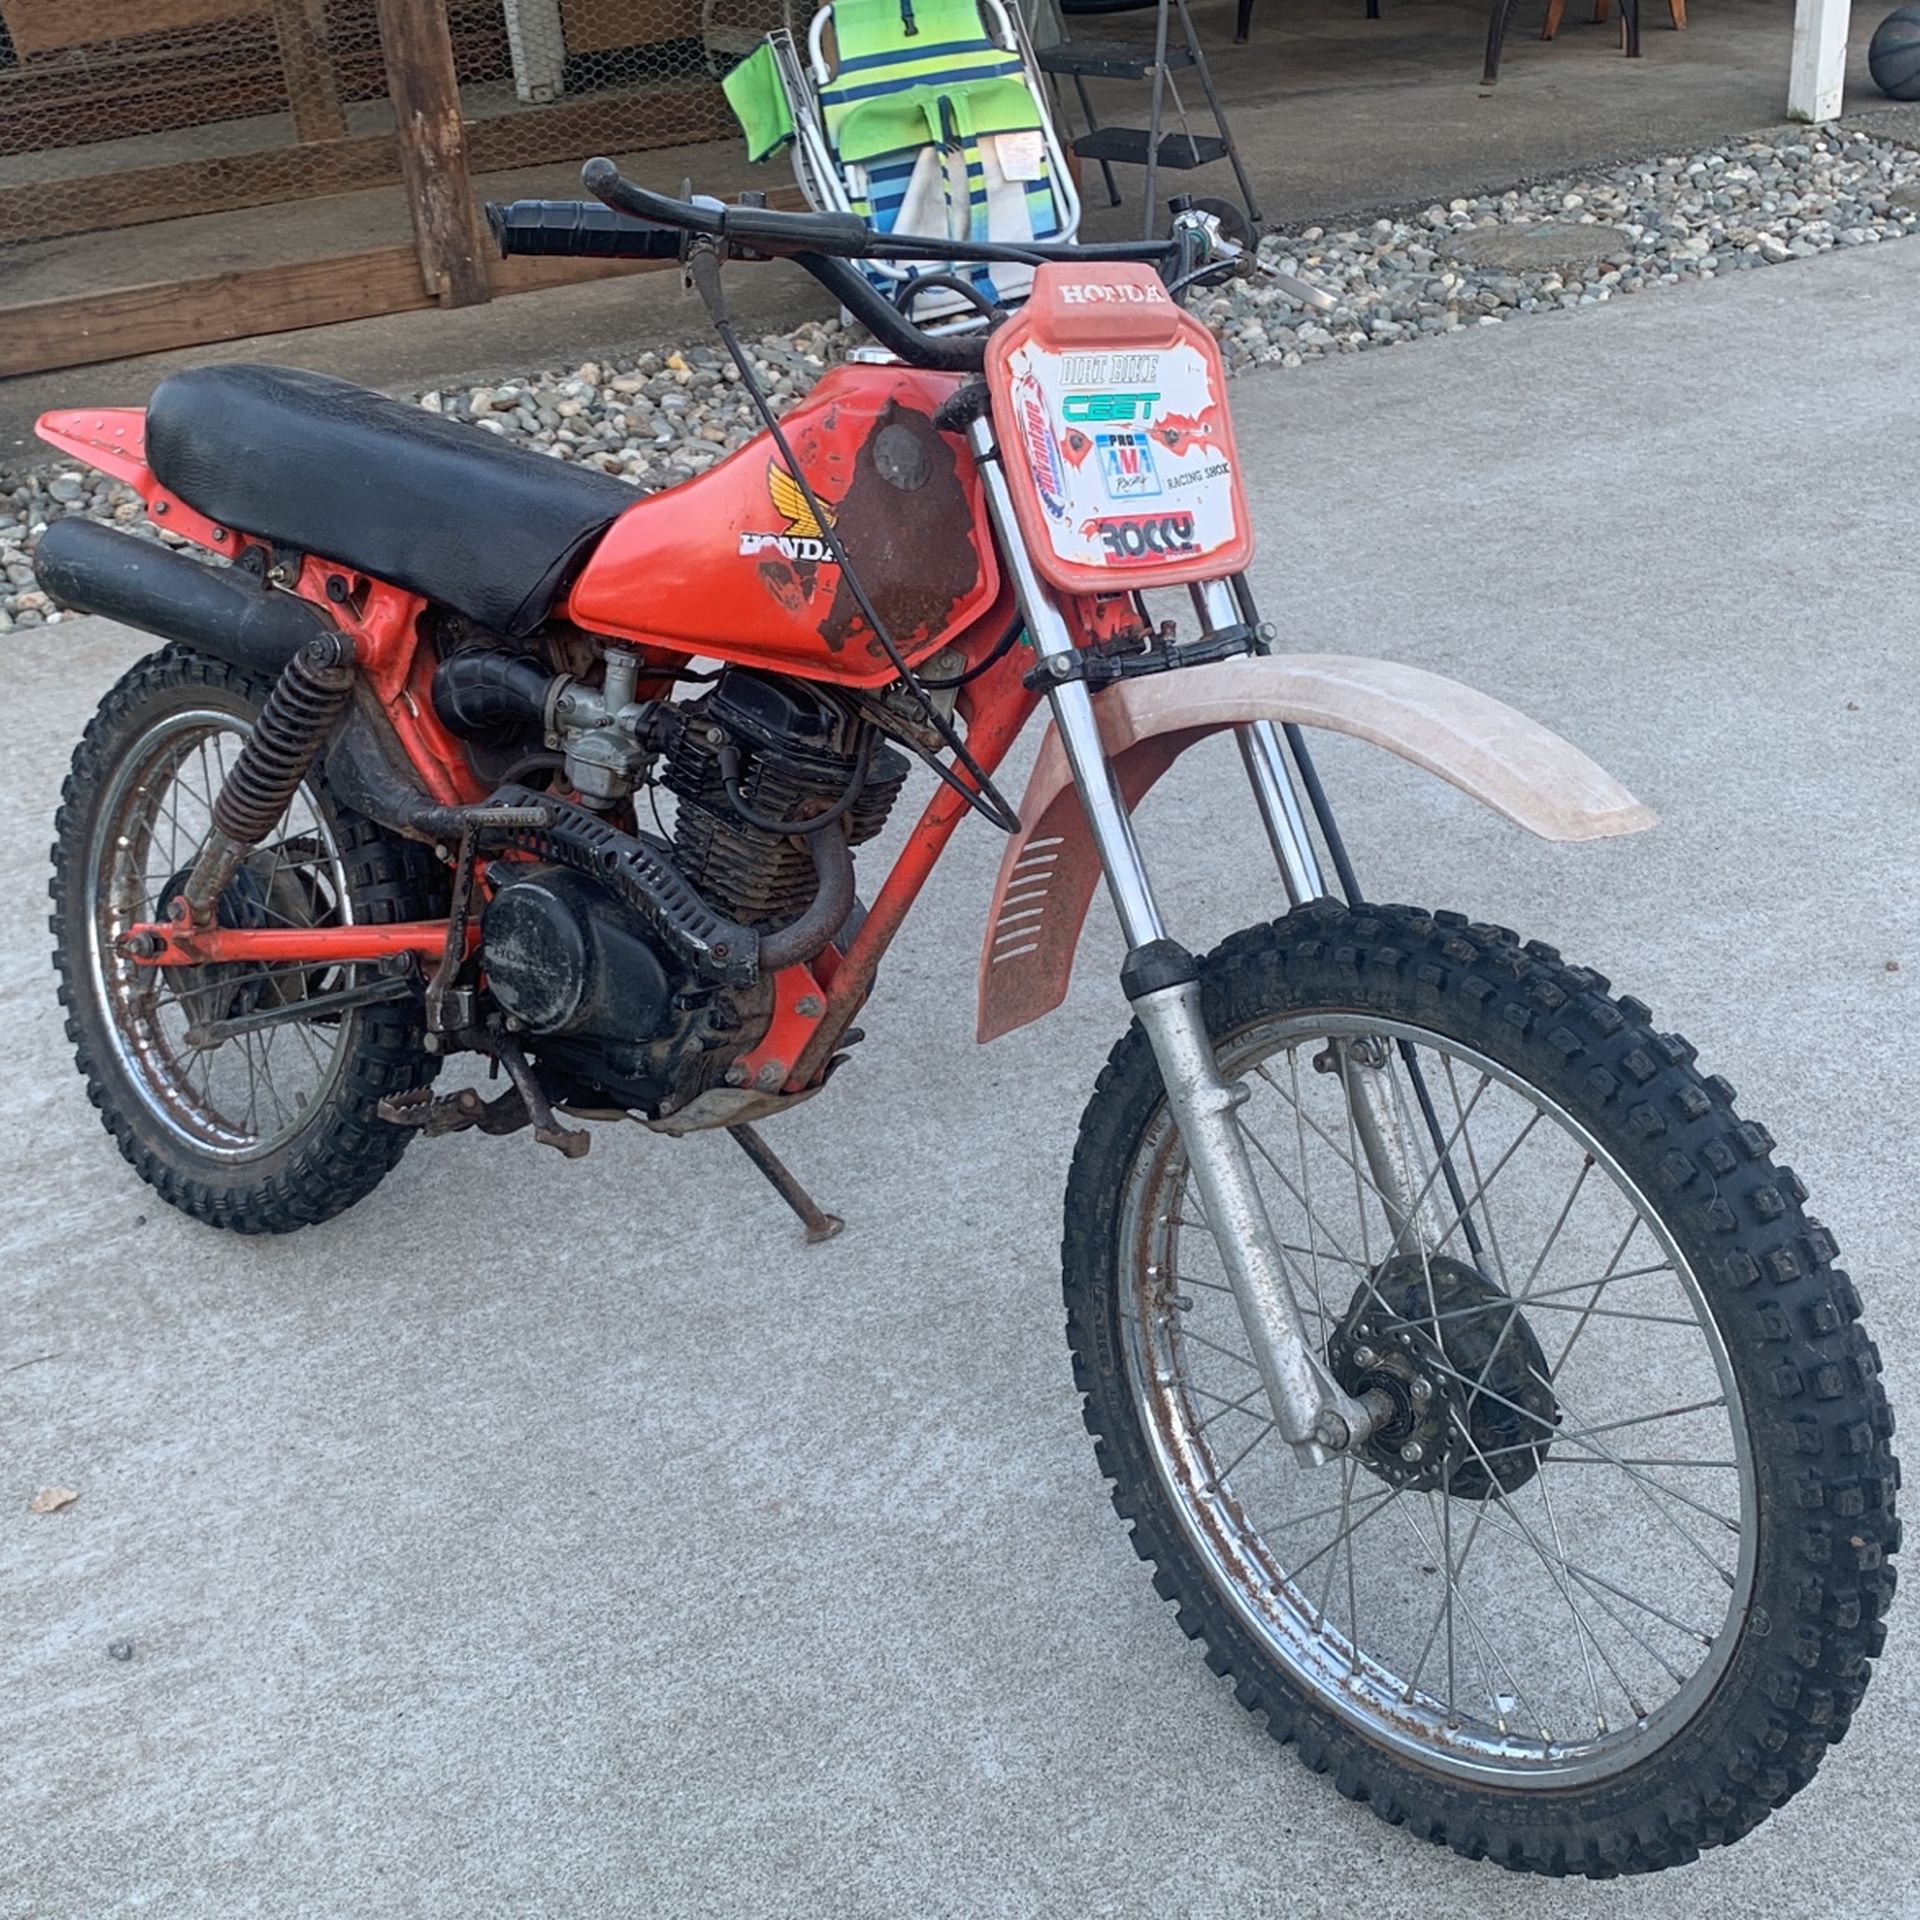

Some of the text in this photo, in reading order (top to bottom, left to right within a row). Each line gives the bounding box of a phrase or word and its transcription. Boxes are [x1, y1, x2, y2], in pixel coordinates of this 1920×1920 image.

[1059, 284, 1166, 303] HONDA
[1060, 356, 1108, 385] DIRT
[1109, 355, 1159, 383] BIKE
[1062, 392, 1161, 422] CEET
[1108, 434, 1135, 446] PRO
[1108, 448, 1151, 475] AMA
[1166, 470, 1202, 490] RACING
